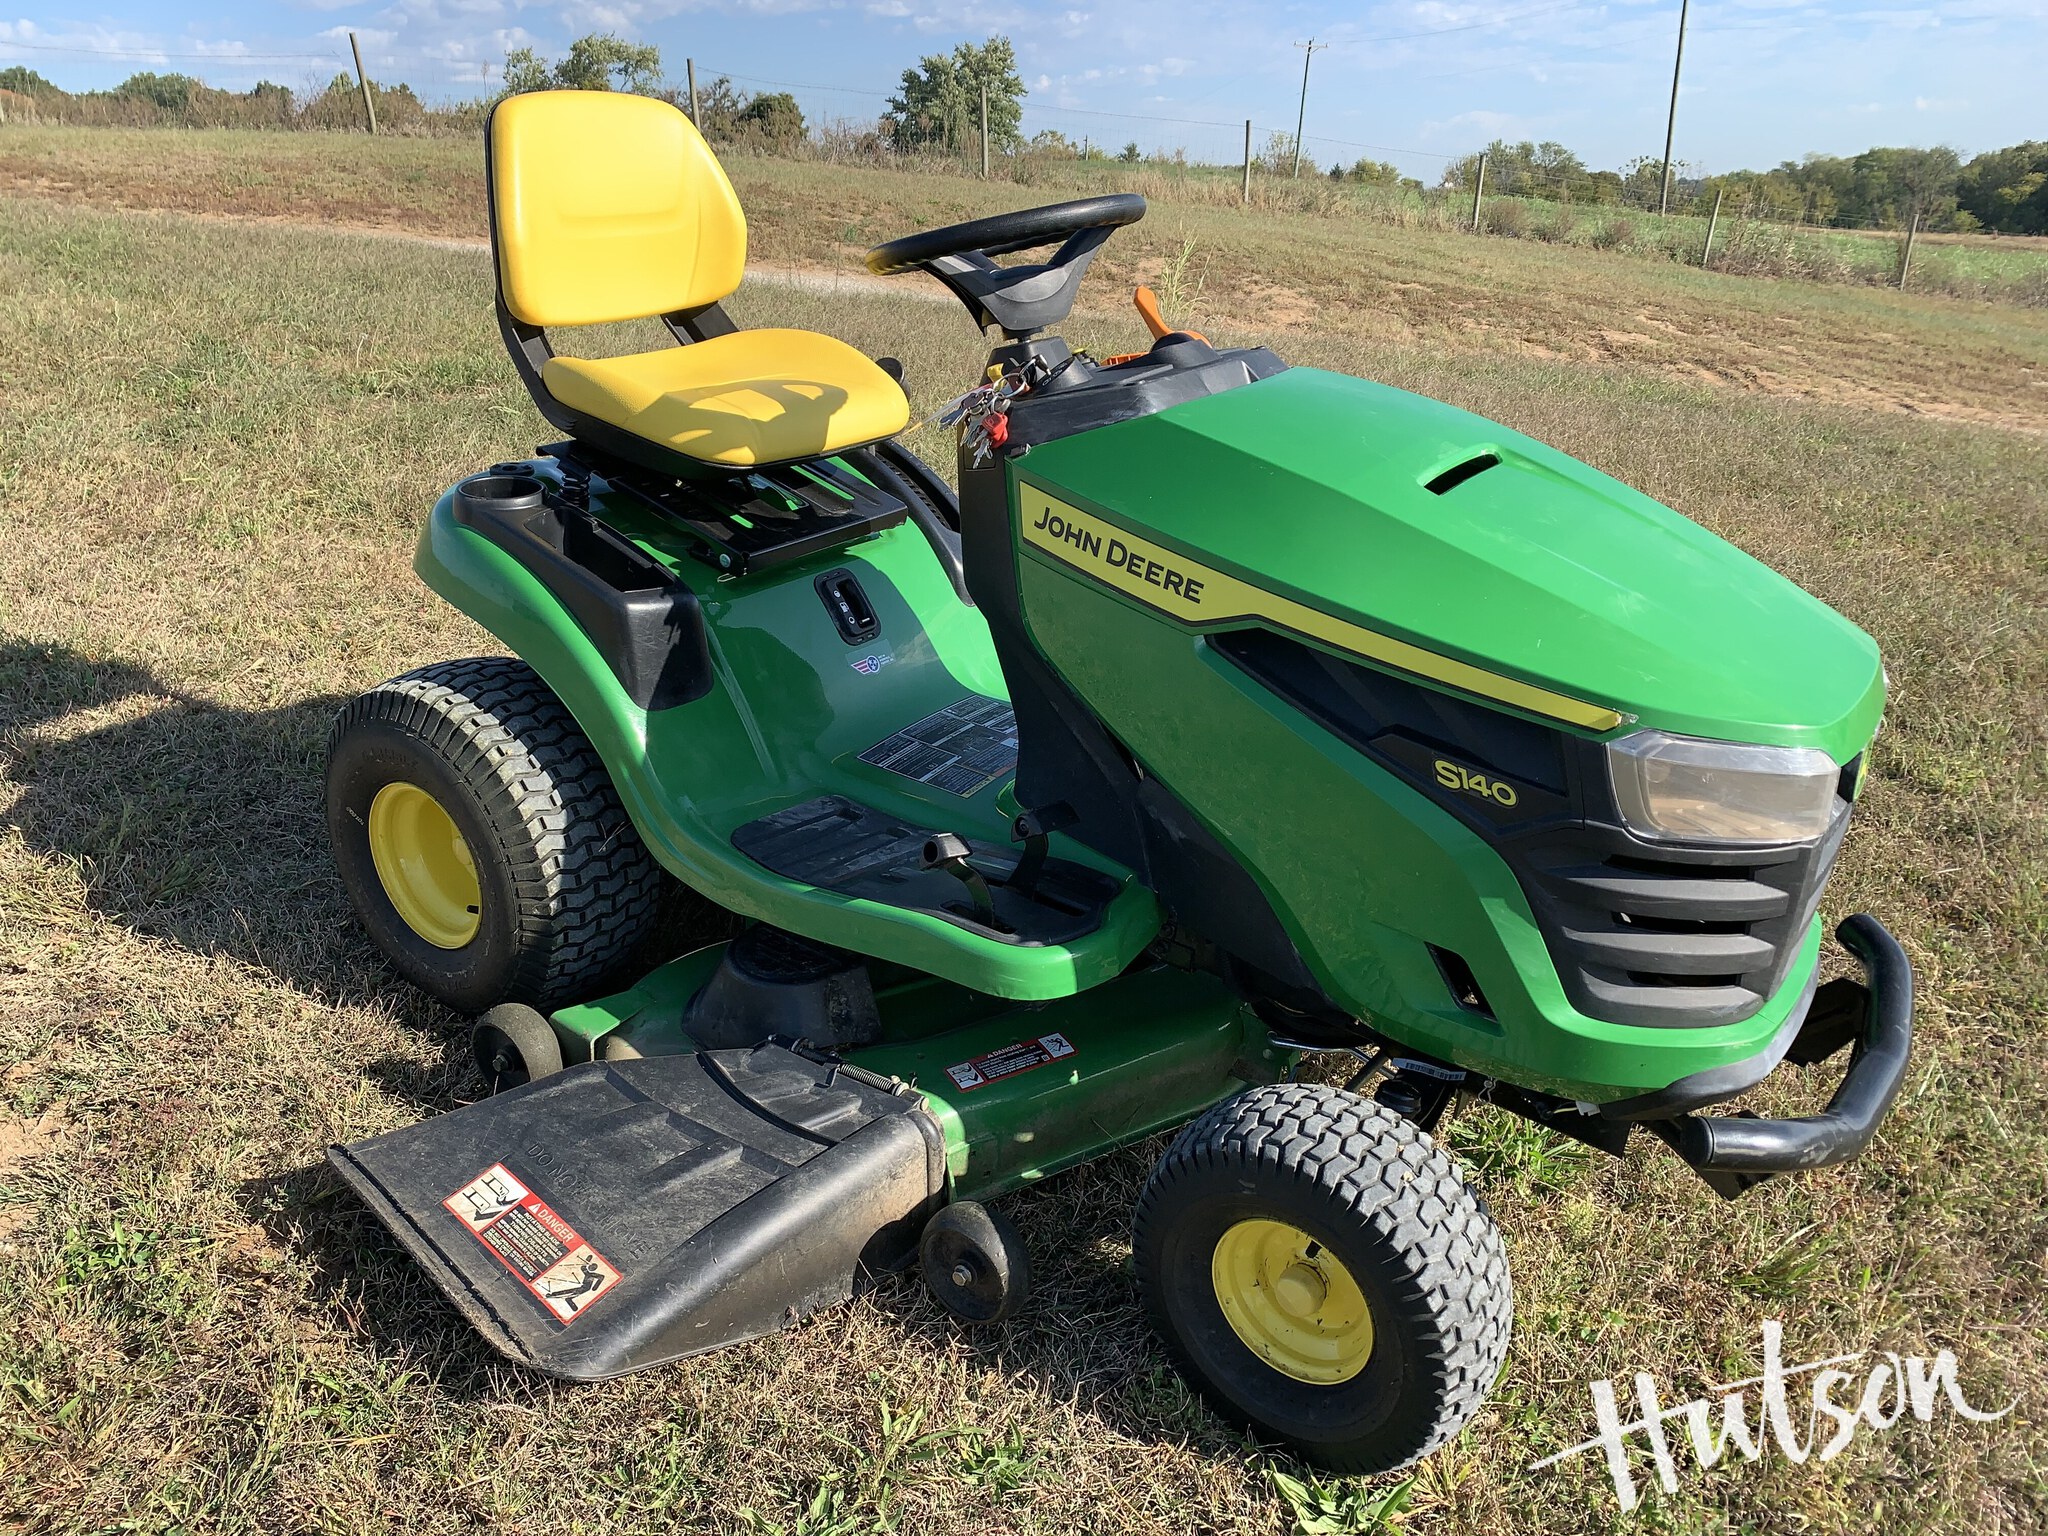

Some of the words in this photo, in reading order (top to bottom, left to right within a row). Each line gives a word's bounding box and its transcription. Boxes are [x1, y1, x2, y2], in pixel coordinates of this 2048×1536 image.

[1034, 507, 1101, 557] JOHN
[1106, 538, 1204, 604] DEERE
[1434, 760, 1517, 806] S140
[992, 1044, 1023, 1058] DANGER
[527, 1142, 555, 1167] DO
[547, 1163, 591, 1198] NOT
[509, 1220, 529, 1239] THROWN
[526, 1237, 548, 1257] OBJECTS
[522, 1211, 546, 1233] ROTATING
[543, 1230, 560, 1246] BLADE
[536, 1207, 575, 1242] DANGER
